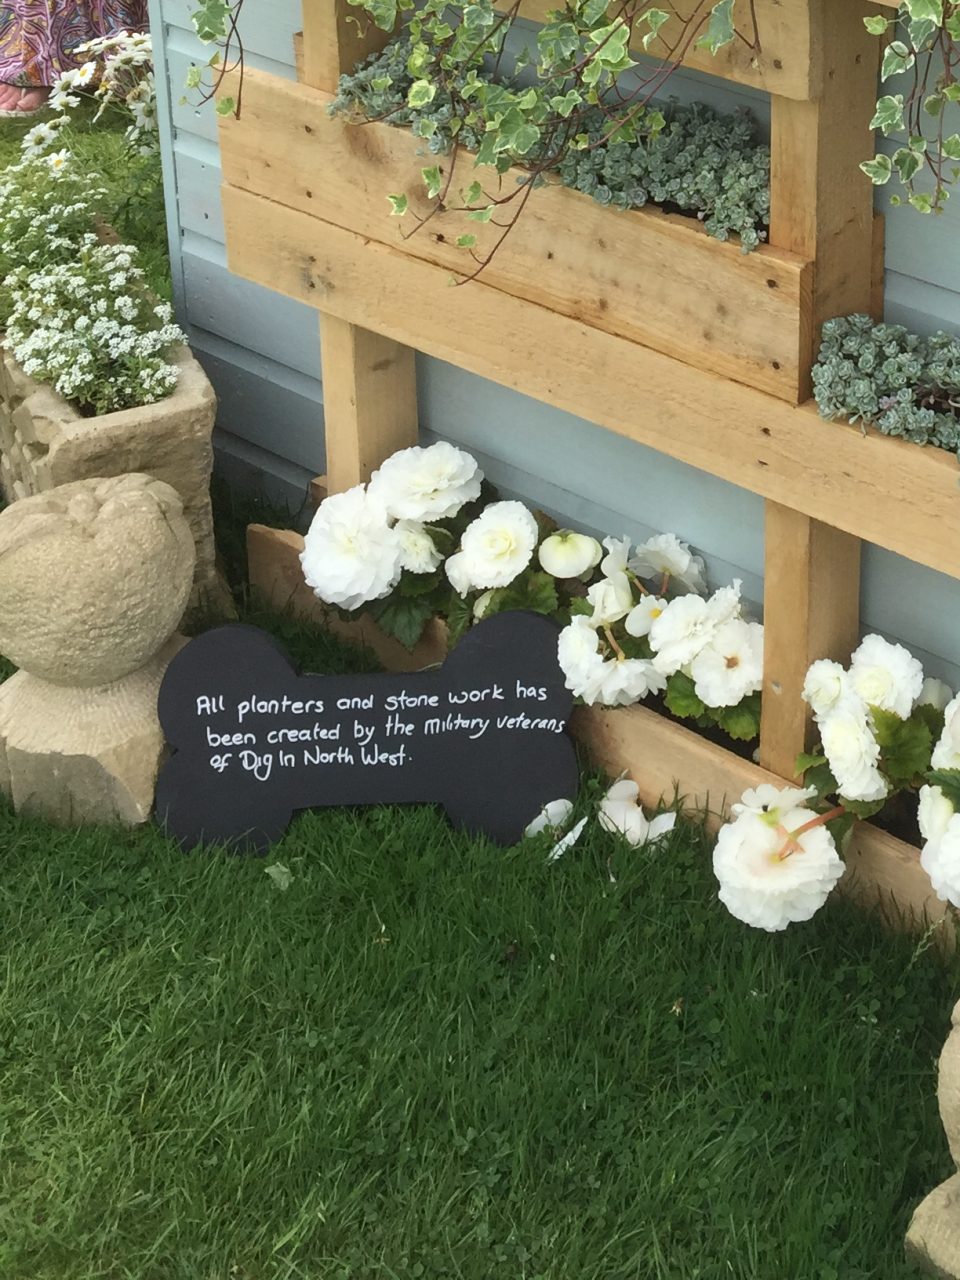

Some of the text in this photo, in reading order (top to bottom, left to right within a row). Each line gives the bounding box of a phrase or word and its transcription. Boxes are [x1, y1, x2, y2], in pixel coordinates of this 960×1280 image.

[197, 679, 548, 723] All planters and stone work has
[206, 726, 257, 747] been
[267, 722, 341, 744] created
[353, 720, 376, 746] by
[385, 713, 415, 736] the
[210, 743, 413, 782] of Dig In North West.
